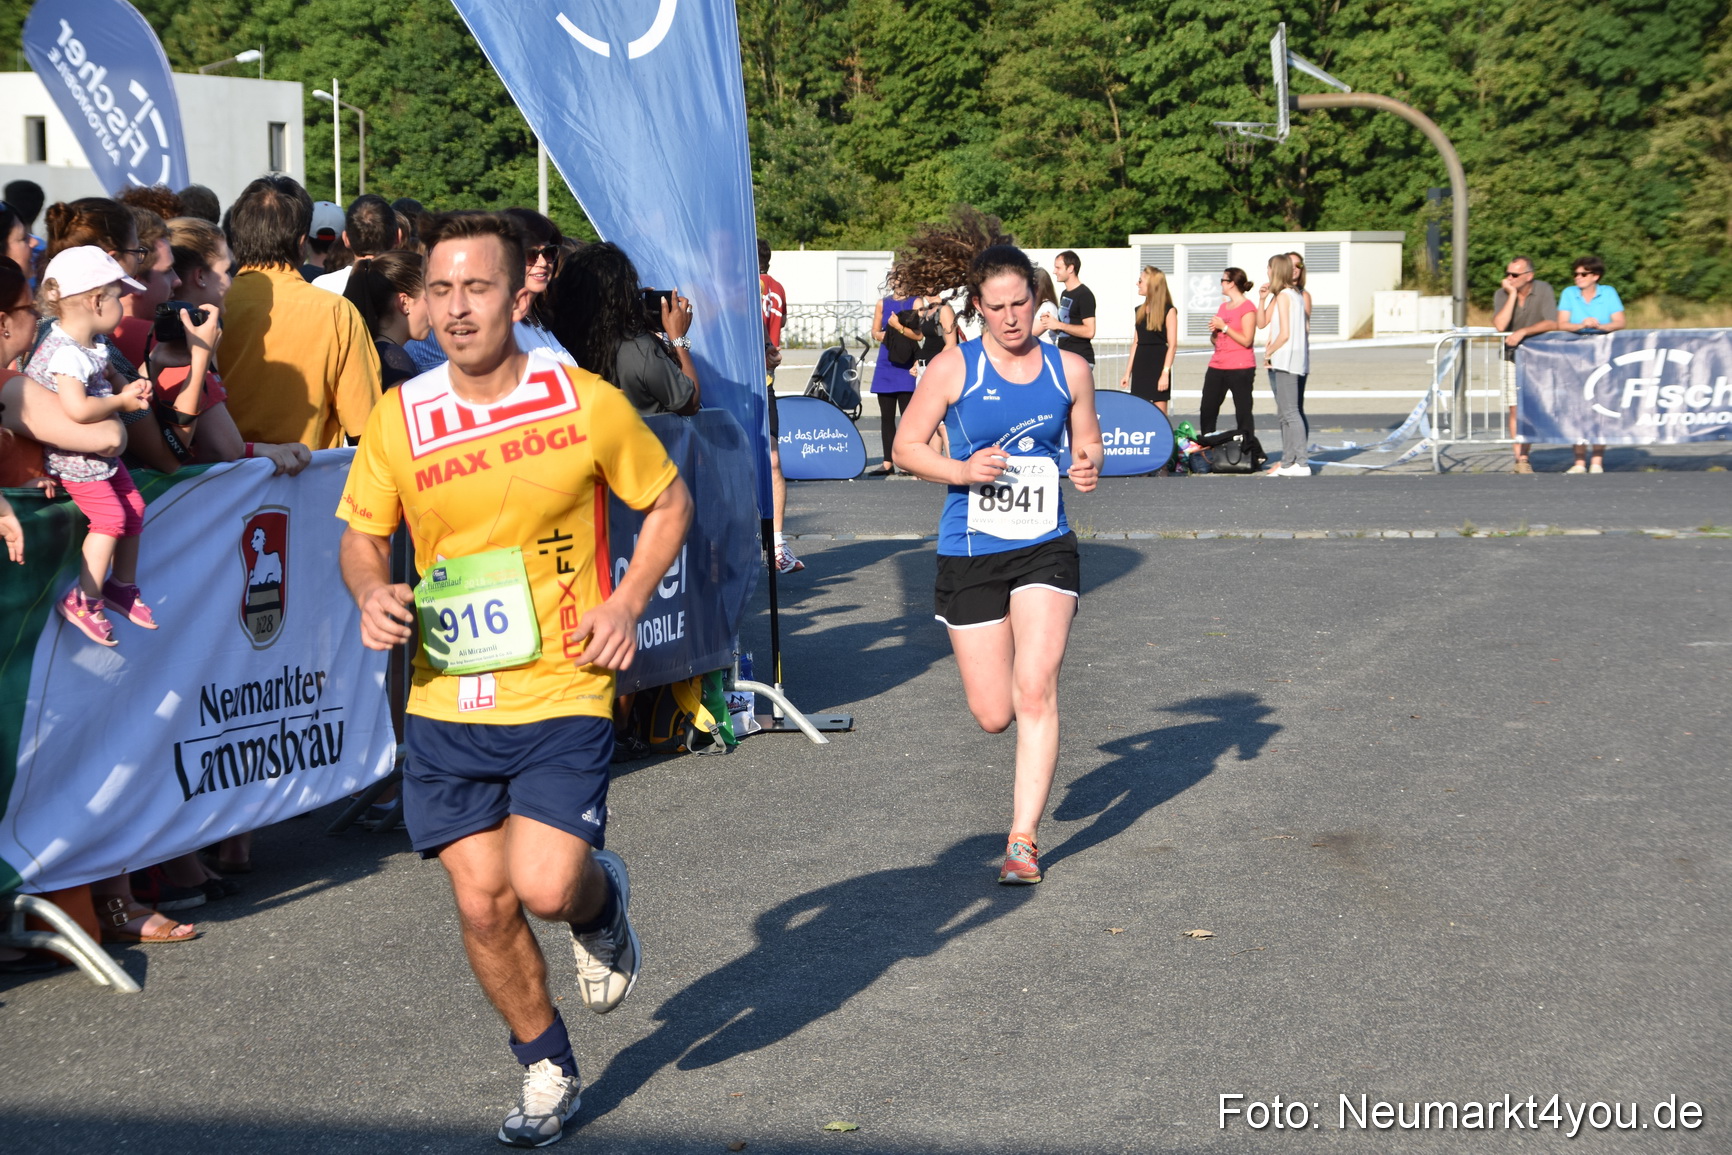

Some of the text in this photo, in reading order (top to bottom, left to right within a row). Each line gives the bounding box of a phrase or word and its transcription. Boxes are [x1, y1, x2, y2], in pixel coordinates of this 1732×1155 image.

[1620, 375, 1732, 409] Fisch
[777, 431, 793, 444] nd
[794, 428, 813, 440] das
[1009, 417, 1037, 434] Schick
[1037, 413, 1054, 422] Bau
[1101, 427, 1156, 446] cher
[163, 427, 185, 455] SONY
[414, 422, 588, 493] MAX BÖGL
[1006, 462, 1046, 476] ports
[978, 483, 1045, 513] 8941
[254, 614, 274, 636] 1628
[439, 598, 509, 643] 916
[200, 664, 326, 727] Neumarkter
[173, 709, 344, 802] Lammsbräu
